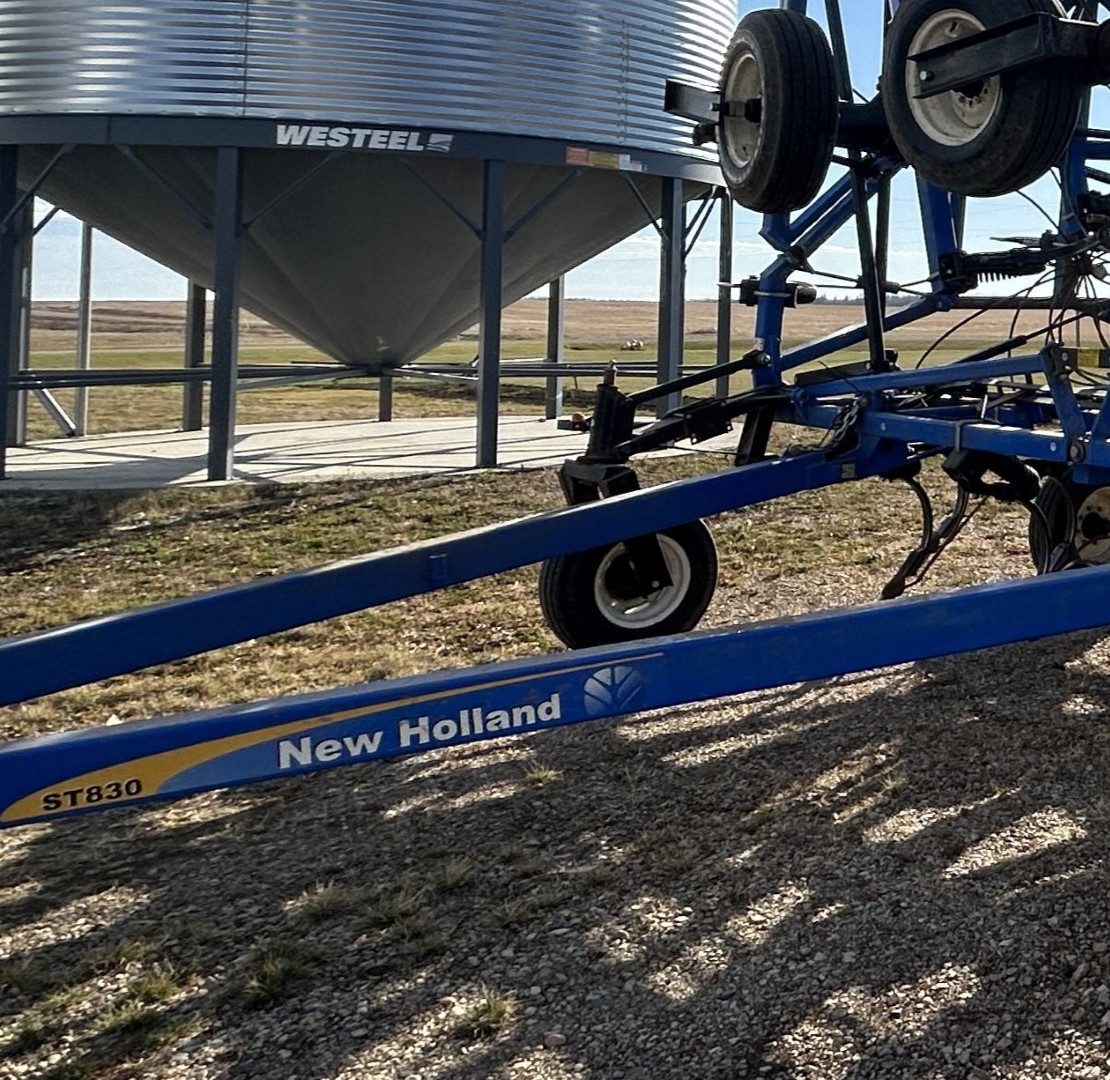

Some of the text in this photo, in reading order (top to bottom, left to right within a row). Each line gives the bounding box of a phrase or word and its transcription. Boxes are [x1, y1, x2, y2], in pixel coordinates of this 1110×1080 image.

[276, 124, 425, 152] WESTEEL
[278, 693, 561, 769] New Holland
[42, 779, 142, 811] ST830
